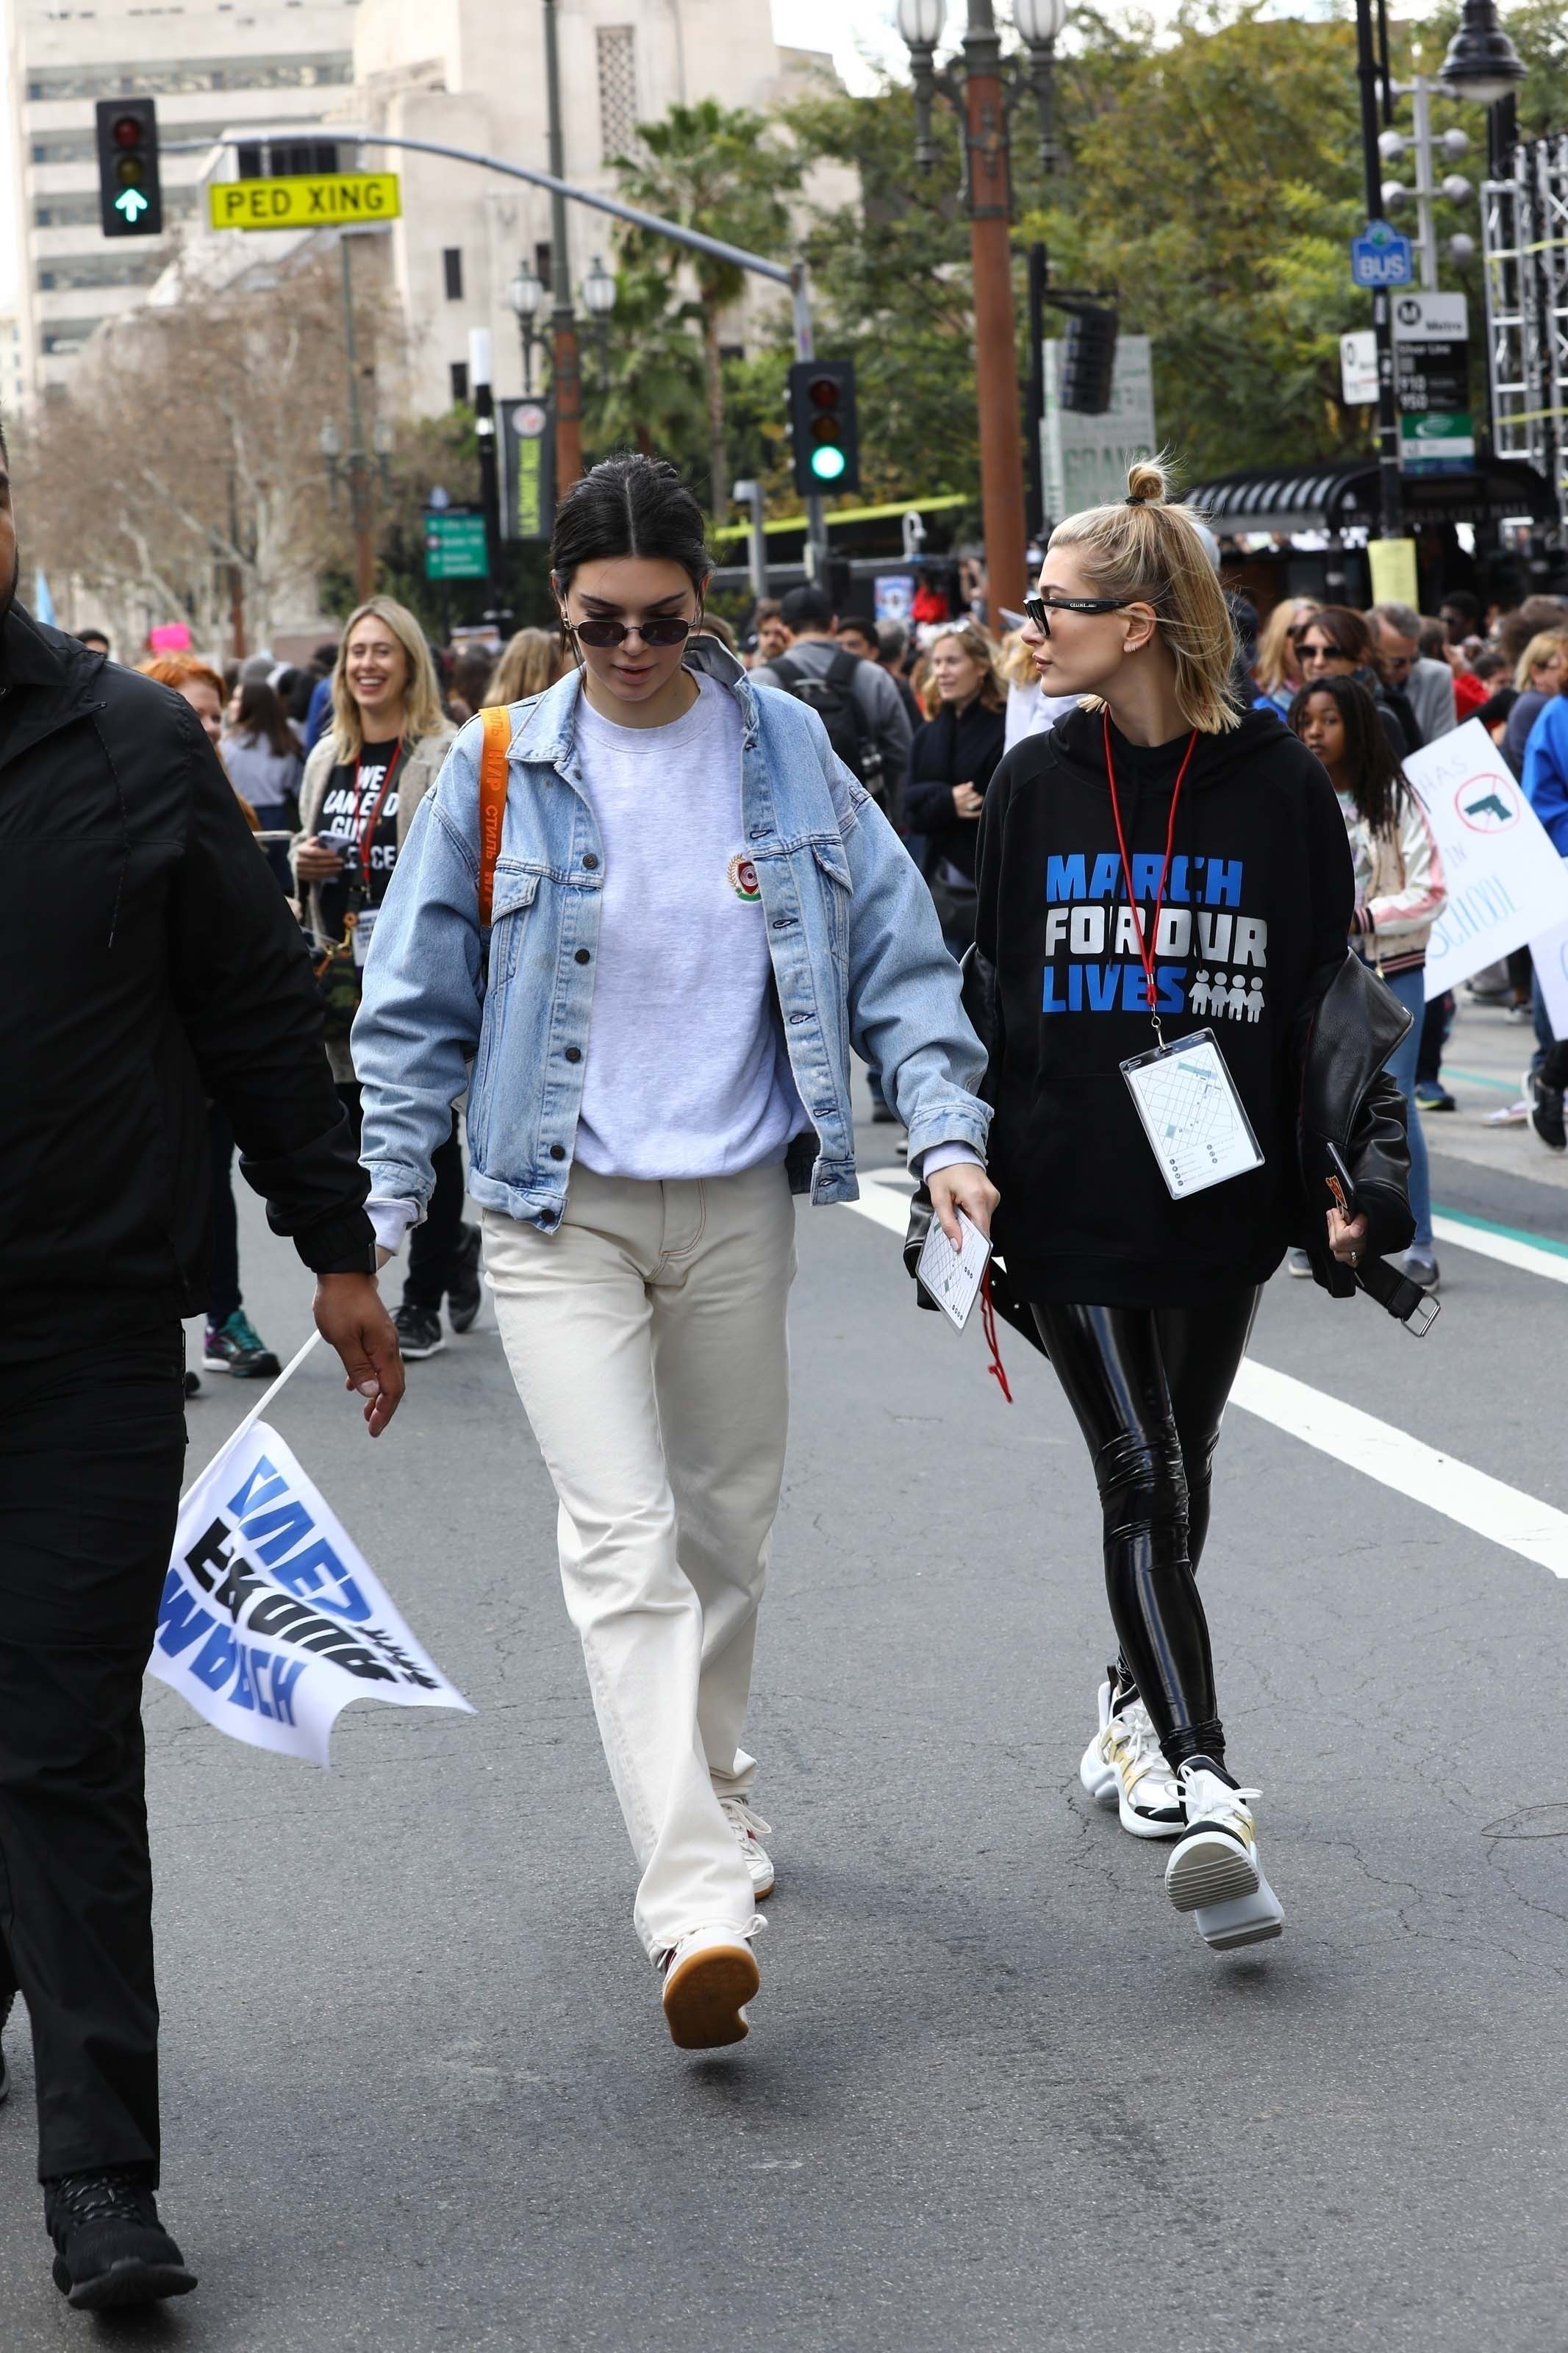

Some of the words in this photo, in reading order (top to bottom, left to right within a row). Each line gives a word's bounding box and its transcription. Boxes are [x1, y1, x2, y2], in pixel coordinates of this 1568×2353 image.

[226, 188, 292, 218] PED
[308, 182, 384, 214] XING
[1361, 254, 1406, 279] BUS
[358, 765, 387, 791] WE
[1046, 853, 1243, 907] MARCH
[1045, 906, 1146, 957] FOR
[1155, 908, 1268, 968] OUR
[1042, 964, 1188, 1013] LIVES
